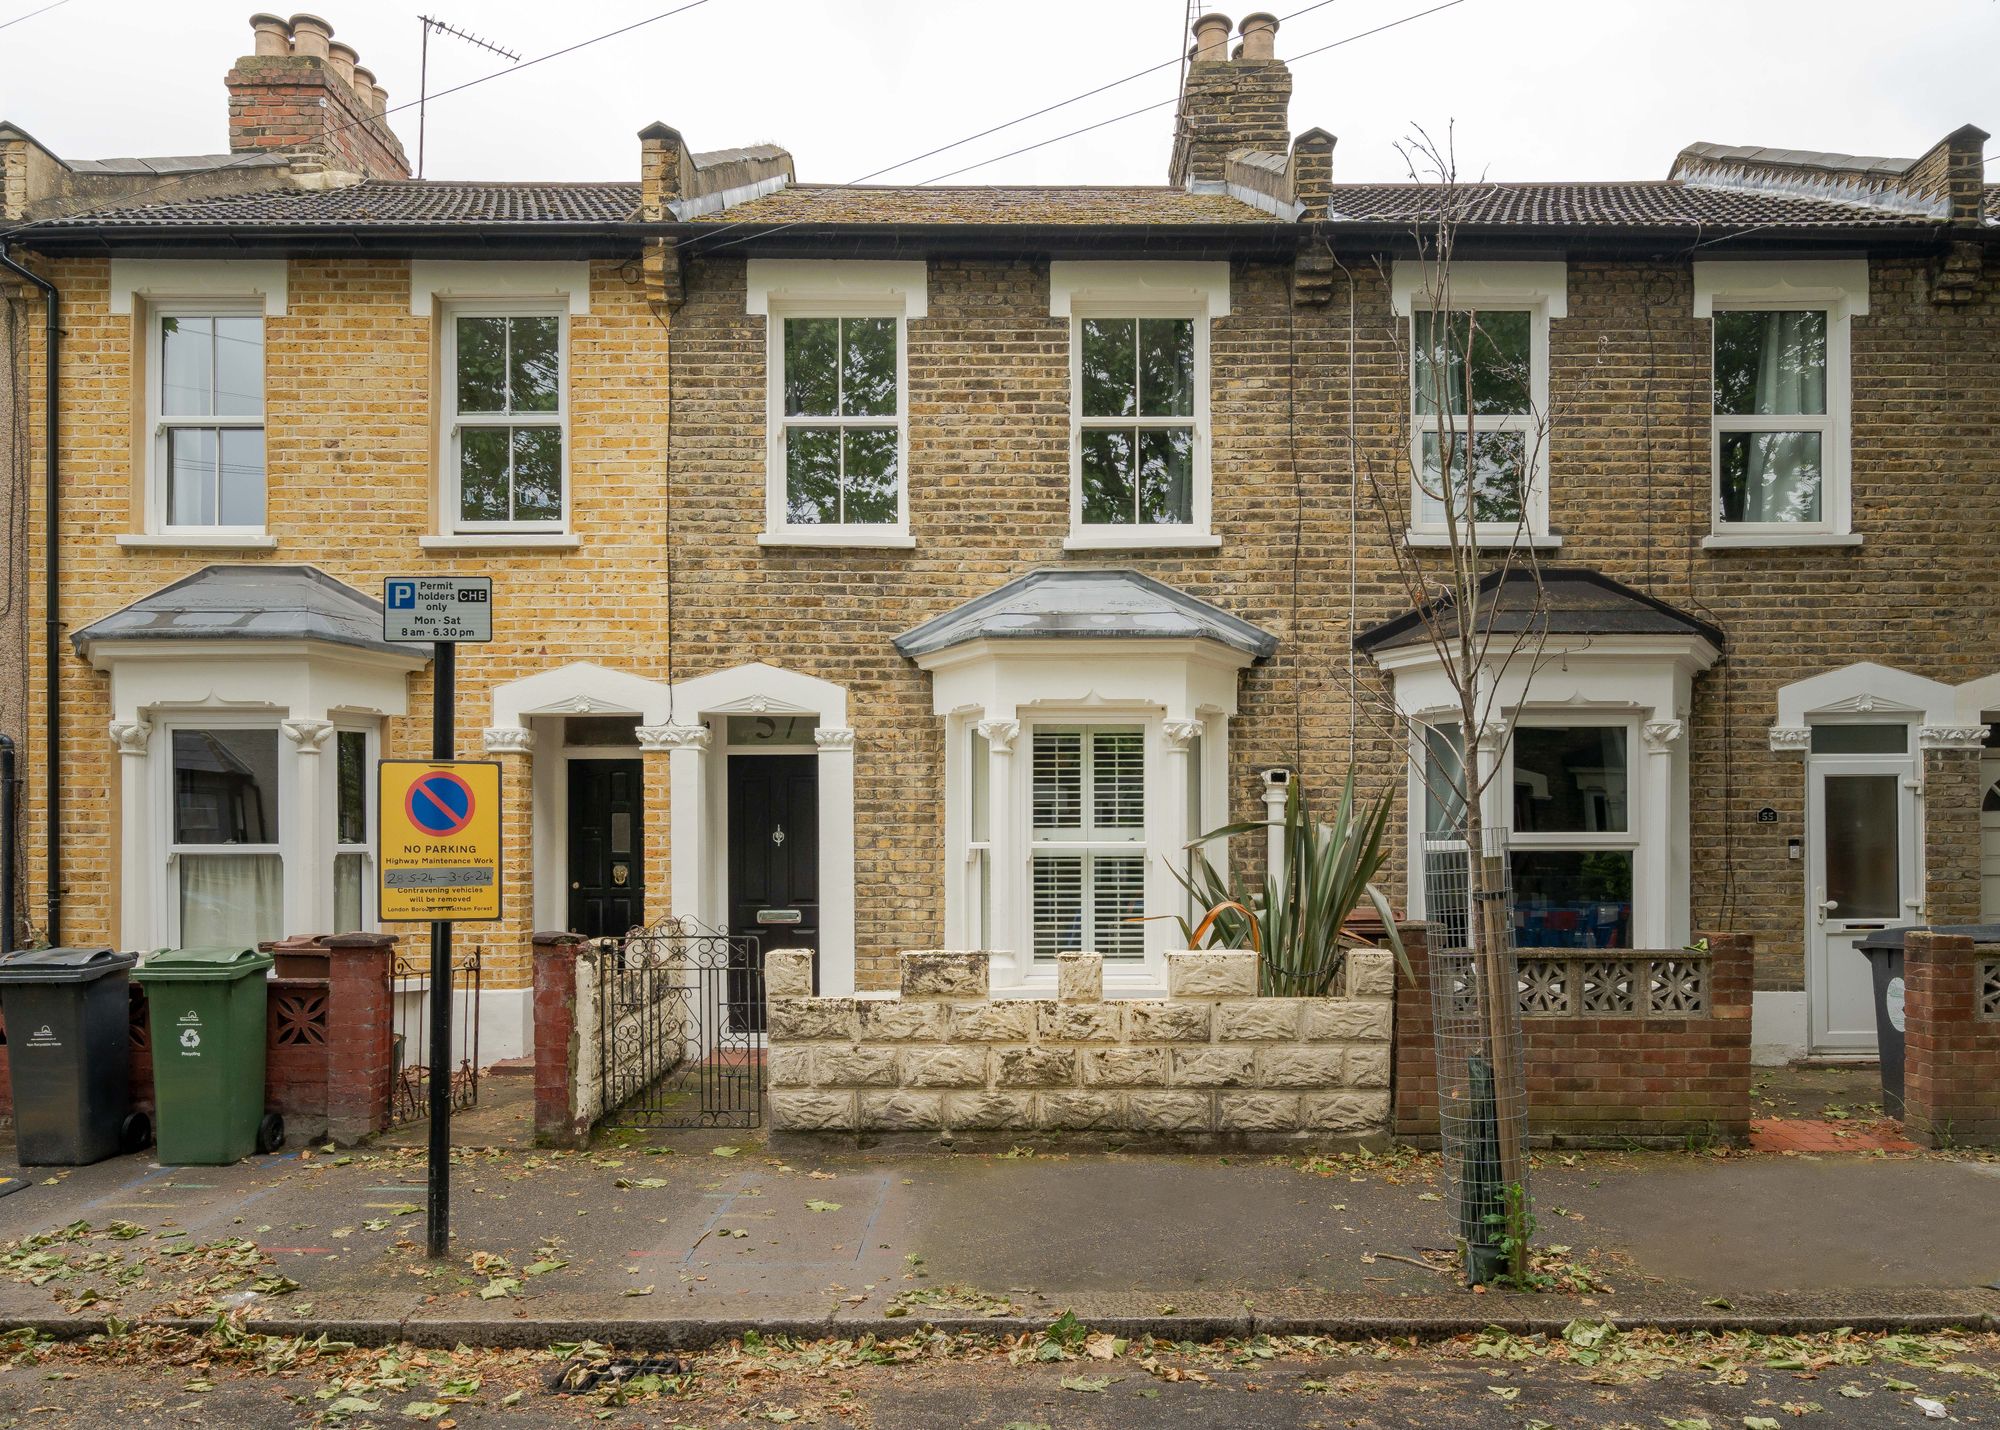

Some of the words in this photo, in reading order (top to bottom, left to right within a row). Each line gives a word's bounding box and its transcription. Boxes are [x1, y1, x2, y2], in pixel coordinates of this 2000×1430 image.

[420, 582, 453, 590] Permit
[395, 585, 411, 606] P
[418, 592, 455, 600] holders
[460, 591, 486, 600] CHE
[426, 603, 448, 612] only
[414, 616, 436, 624] Mon
[444, 616, 461, 624] Sat
[402, 628, 408, 636] 8
[433, 628, 457, 636] 6.30
[460, 629, 474, 637] pm
[1762, 812, 1774, 820] 55
[404, 845, 421, 853] NO
[426, 845, 476, 853] PARKING
